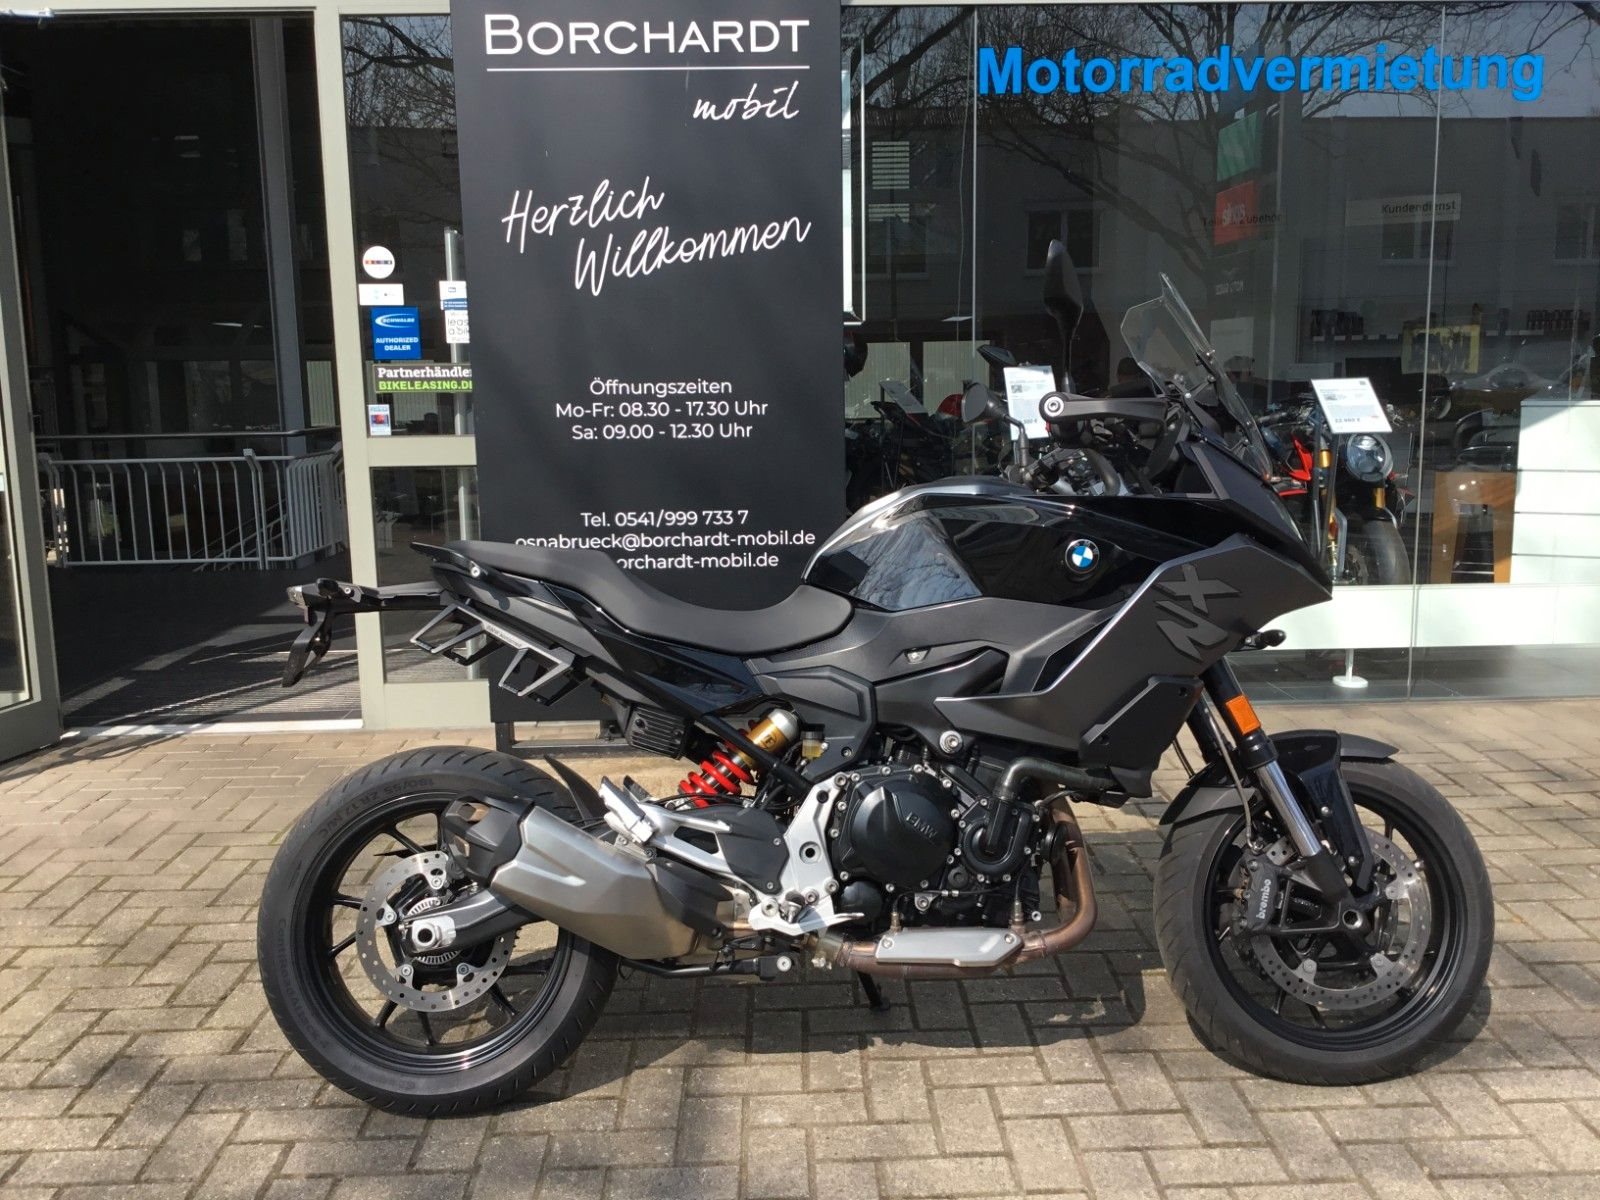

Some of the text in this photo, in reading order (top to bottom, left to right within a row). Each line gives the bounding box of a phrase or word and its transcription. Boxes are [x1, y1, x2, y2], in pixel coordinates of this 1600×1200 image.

[484, 13, 811, 55] BORCHARDT
[978, 44, 1545, 101] Motorradvermietung
[692, 80, 800, 121] mobil
[501, 175, 665, 254] Herzlich
[574, 216, 813, 297] Willkommen
[375, 336, 419, 344] AUTHORIZED
[589, 377, 733, 398] Öffnungszeiten
[555, 402, 615, 418] Mo-Fr:
[618, 401, 670, 417] 08.30
[685, 401, 730, 416] 17.30
[734, 400, 769, 416] Uhr
[571, 425, 599, 440] Sa:
[602, 424, 654, 440] 09.00
[669, 423, 714, 439] 12.30
[719, 422, 753, 438] Uhr
[580, 509, 749, 528] Tel. 0541/999 733 7
[515, 529, 816, 552] osnabrueck@borchardt-mobil.de
[1256, 879, 1271, 919] brembo
